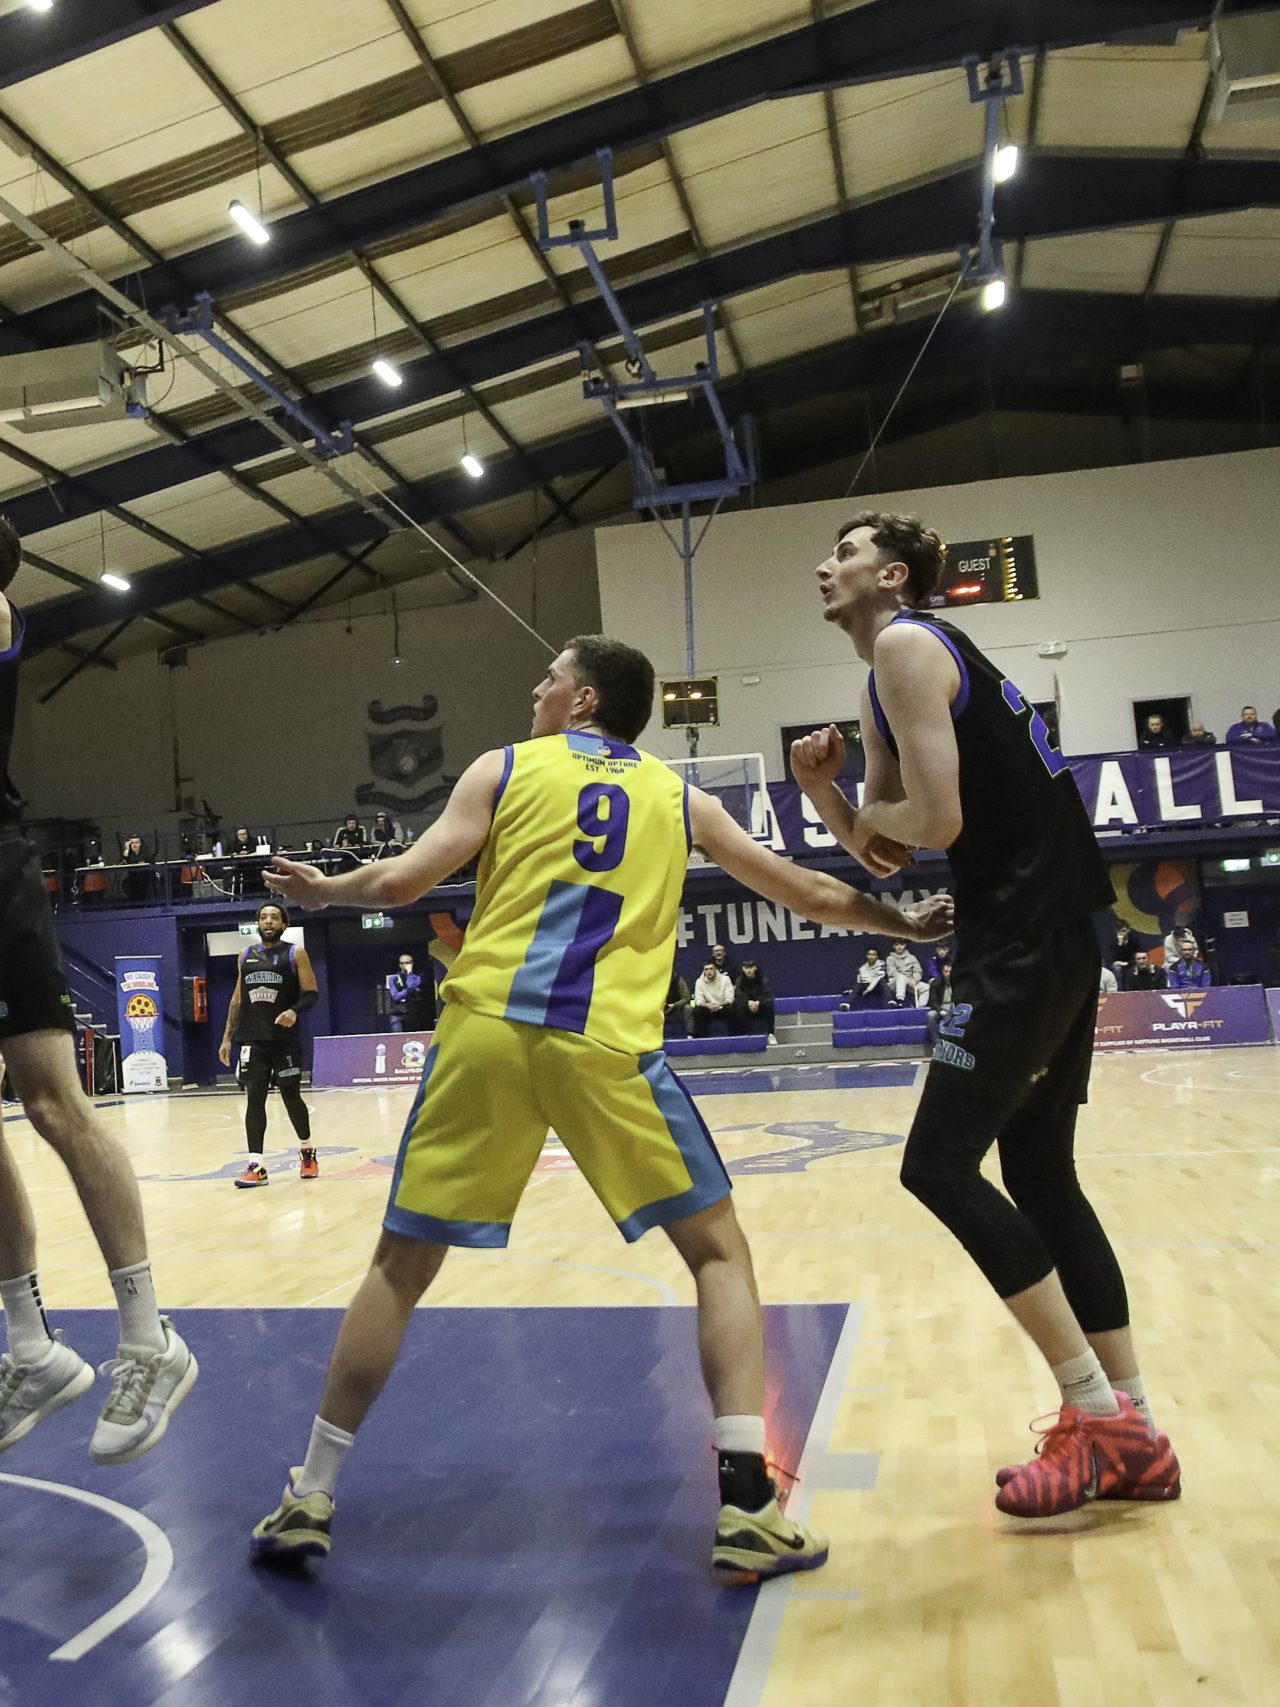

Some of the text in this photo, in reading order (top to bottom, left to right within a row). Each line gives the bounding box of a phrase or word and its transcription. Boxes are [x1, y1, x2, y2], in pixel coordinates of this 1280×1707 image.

[958, 557, 991, 573] GUEST
[585, 764, 600, 773] EST
[572, 782, 630, 873] 9
[1152, 1020, 1224, 1032] PLAYR-FIT
